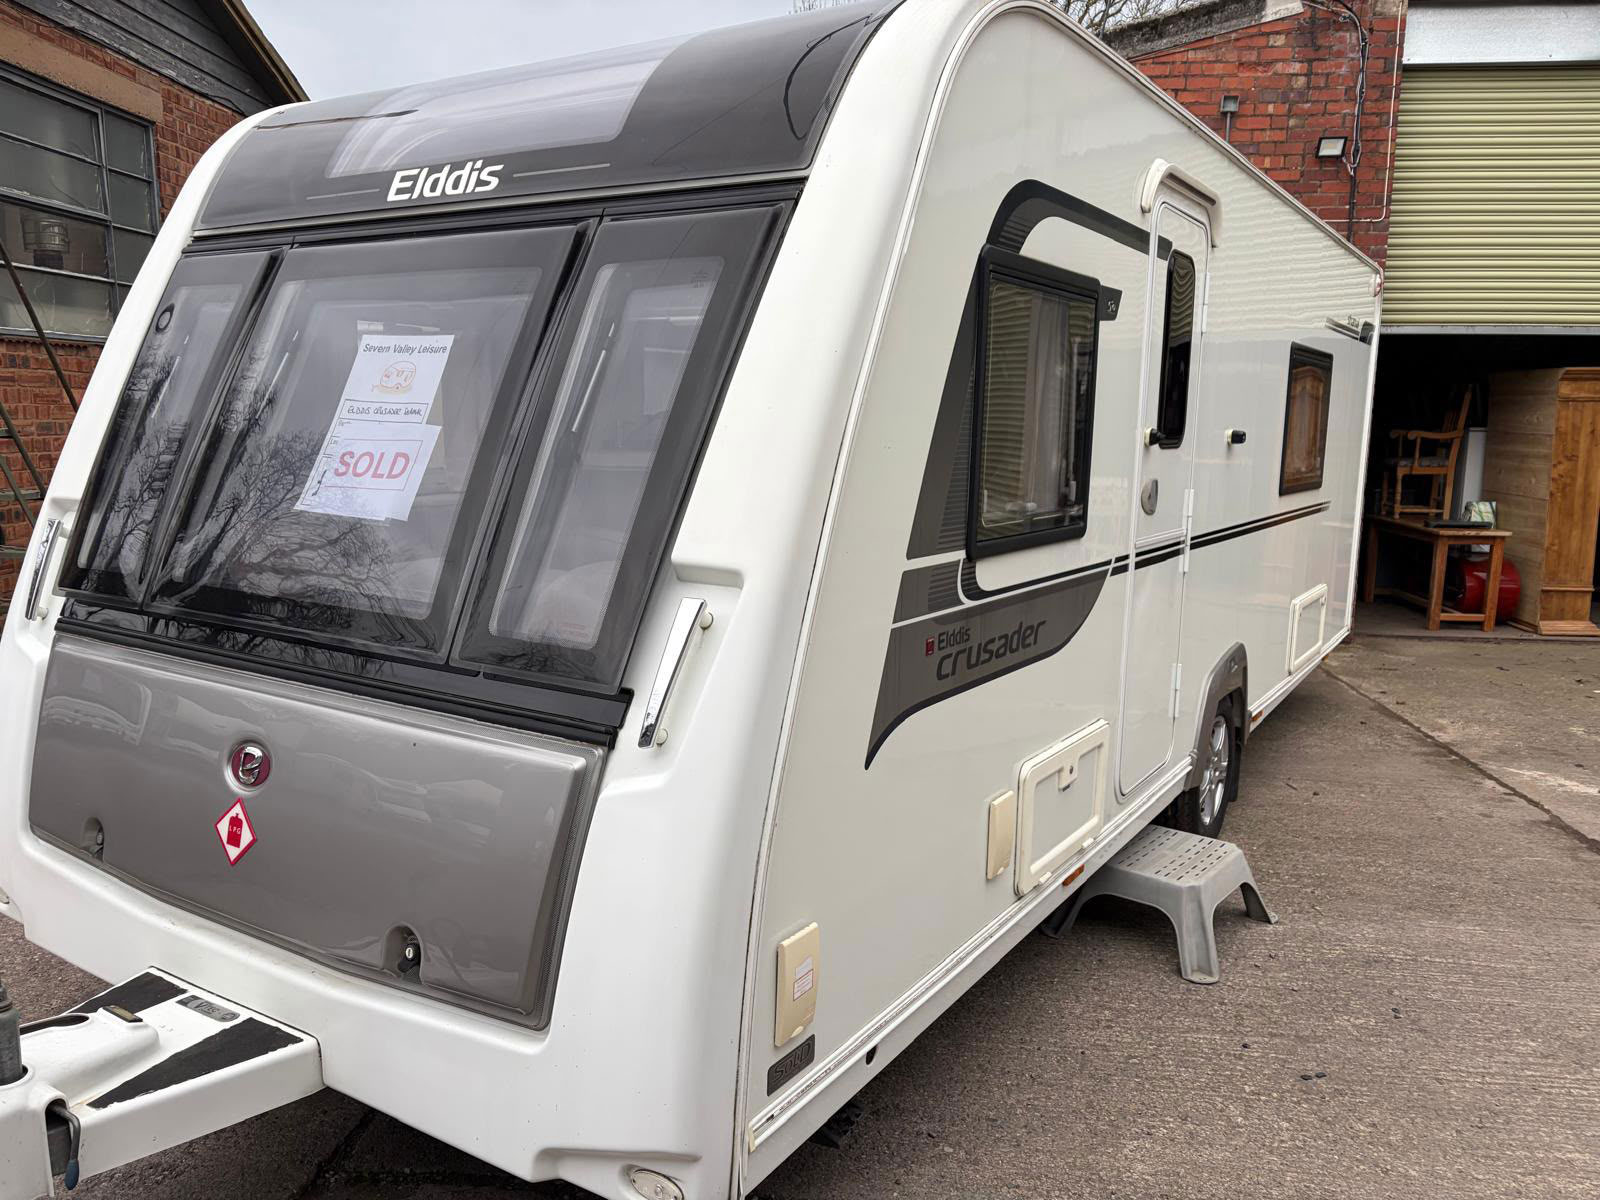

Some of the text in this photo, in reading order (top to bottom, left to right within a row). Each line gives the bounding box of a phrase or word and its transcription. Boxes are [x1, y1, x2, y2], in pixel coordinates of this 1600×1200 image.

[386, 159, 504, 202] Elddis
[363, 343, 448, 356] Severn Valley Leisure
[334, 450, 410, 480] SOLD
[937, 626, 971, 651] Elddis
